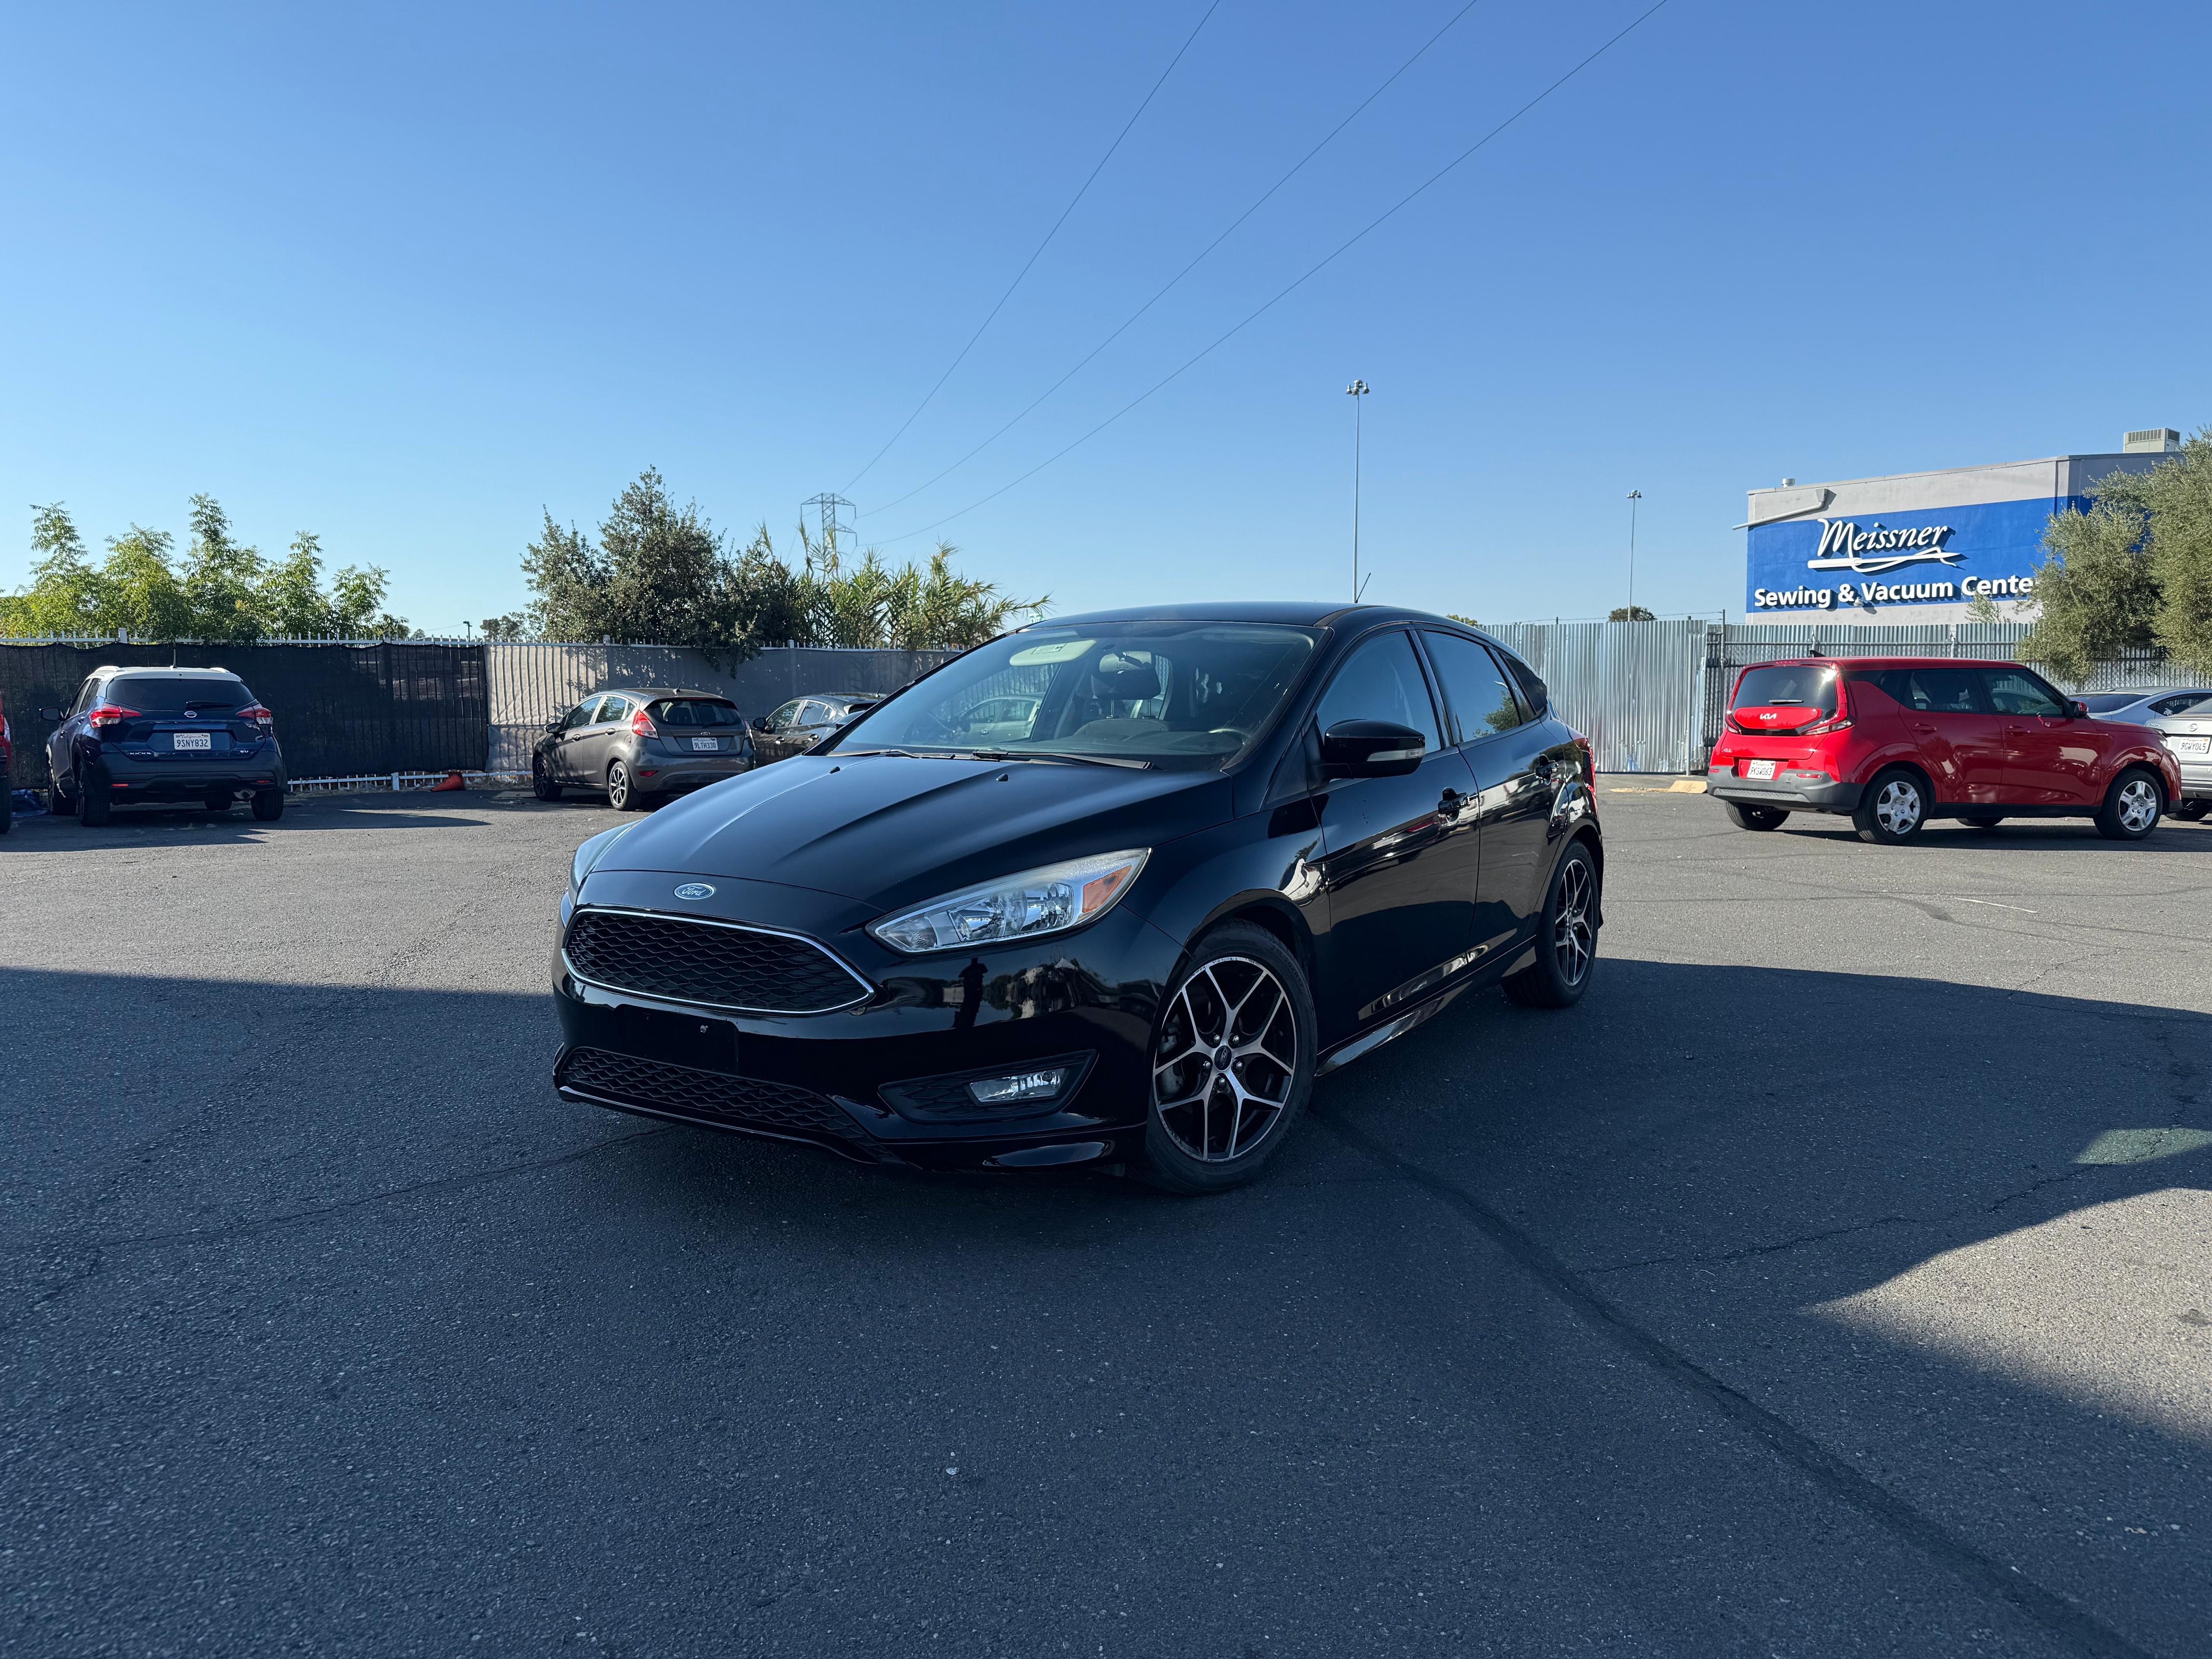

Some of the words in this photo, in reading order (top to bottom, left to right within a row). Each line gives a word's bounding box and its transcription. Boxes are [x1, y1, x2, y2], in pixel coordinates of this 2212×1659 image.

[1817, 518, 1948, 558] Meissner
[1754, 585, 1831, 608] Sewing
[1838, 584, 1855, 602] &
[1861, 582, 1953, 601] Vacuum
[1961, 575, 2039, 596] Cente
[177, 739, 208, 747] 9SNY832
[1749, 767, 1772, 775] 9KSW063
[681, 885, 706, 896] Ford
